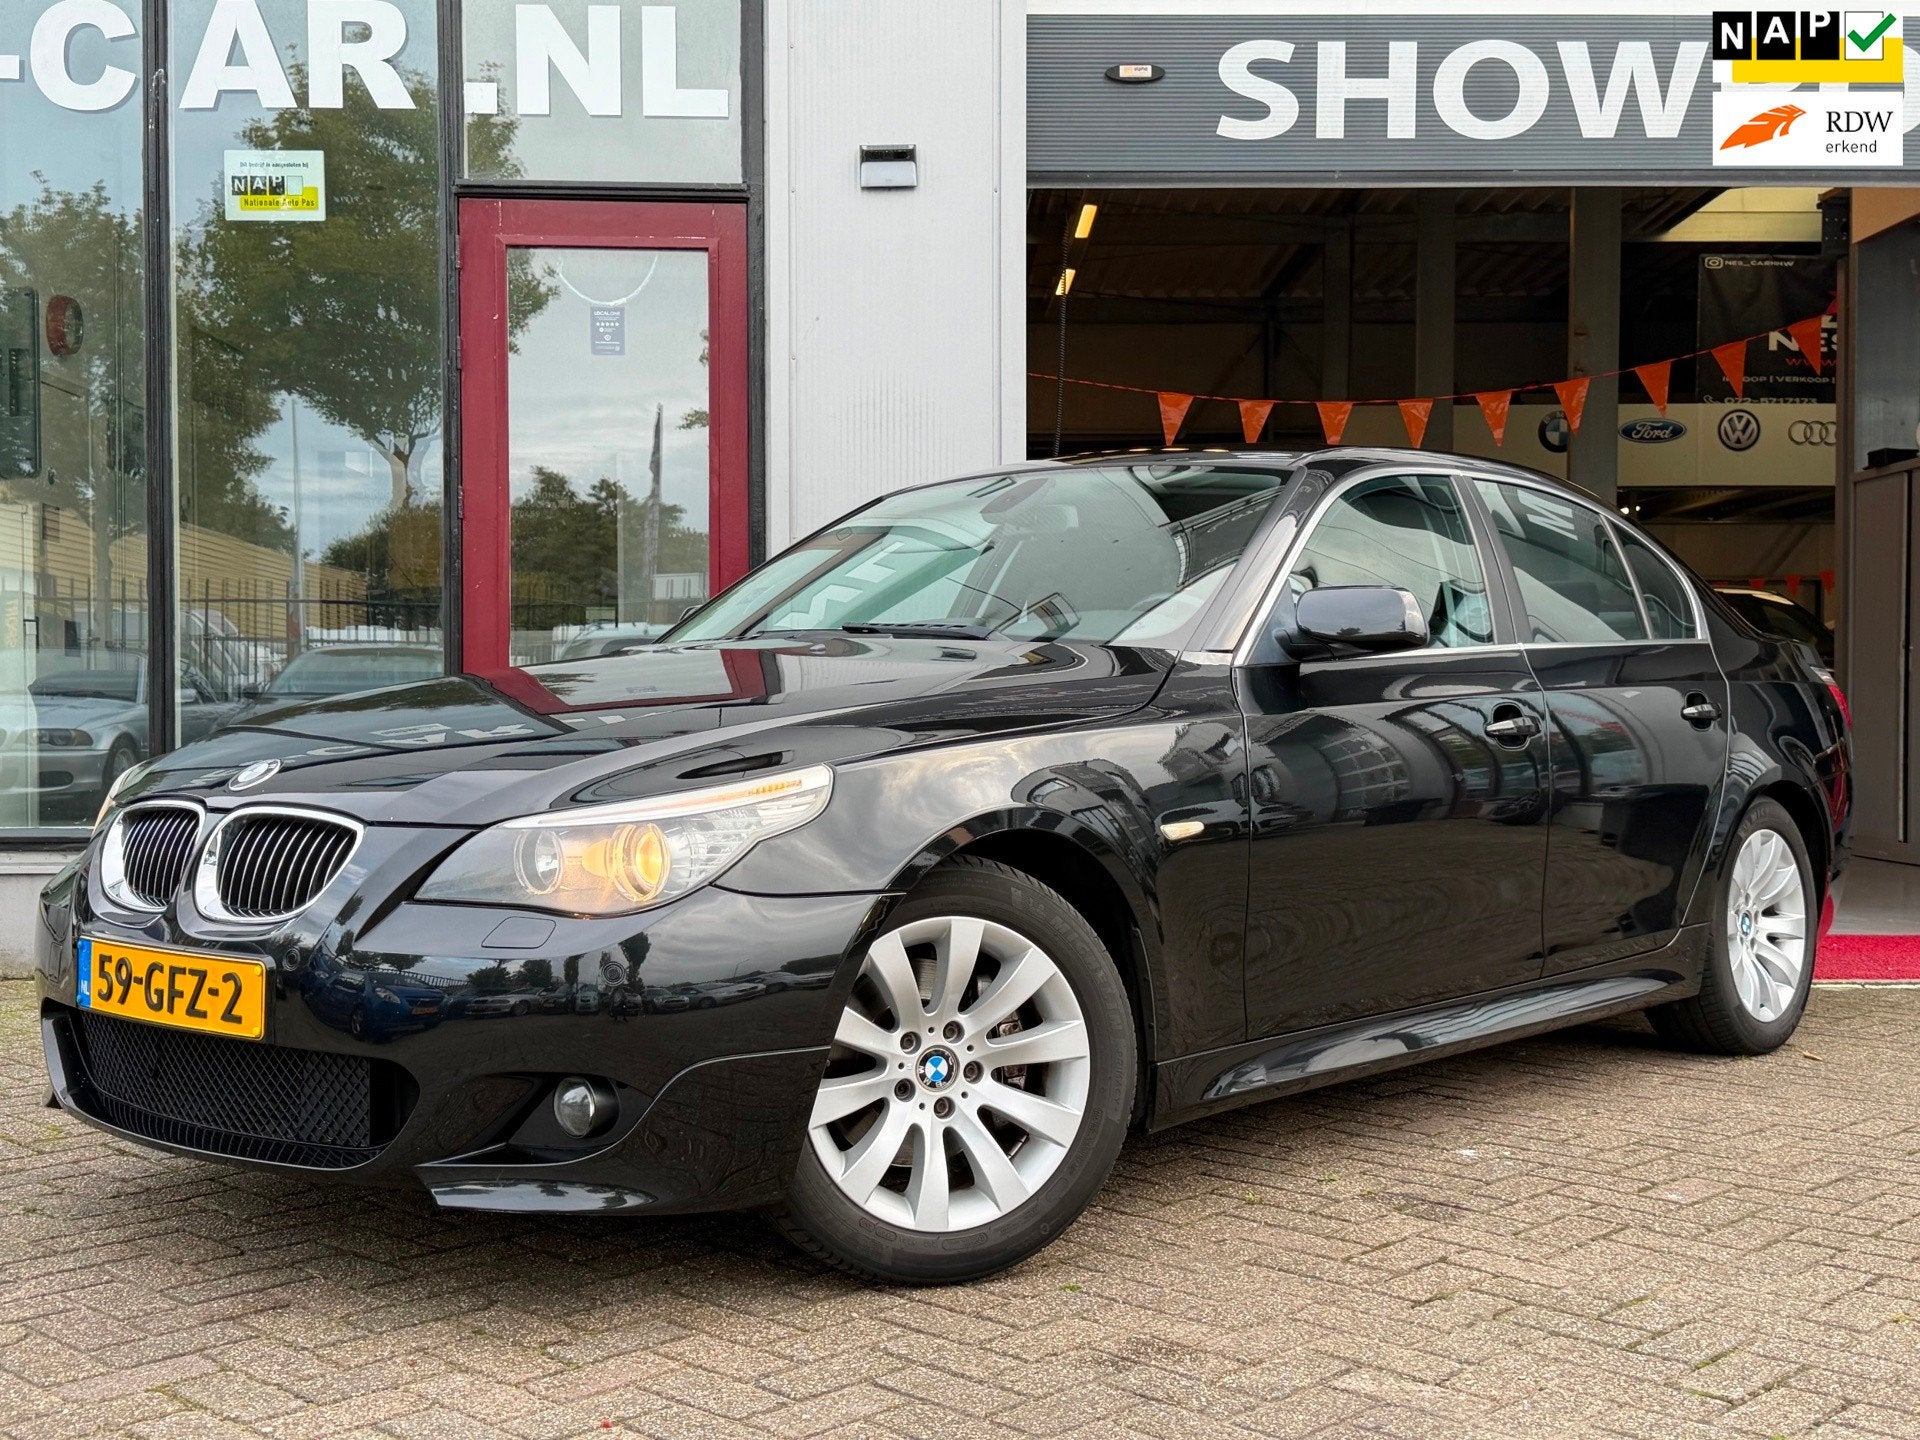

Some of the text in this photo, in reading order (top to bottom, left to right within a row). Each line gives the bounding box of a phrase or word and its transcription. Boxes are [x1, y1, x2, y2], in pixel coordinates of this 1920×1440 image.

[1216, 40, 1920, 141] SHOW
[234, 175, 283, 192] NAP
[244, 198, 315, 207] Nationale Auto Pas
[1776, 376, 1830, 384] VERKOOP
[1632, 421, 1673, 440] Ford
[80, 979, 90, 996] NL
[97, 953, 243, 1024] 59-GFZ-2
